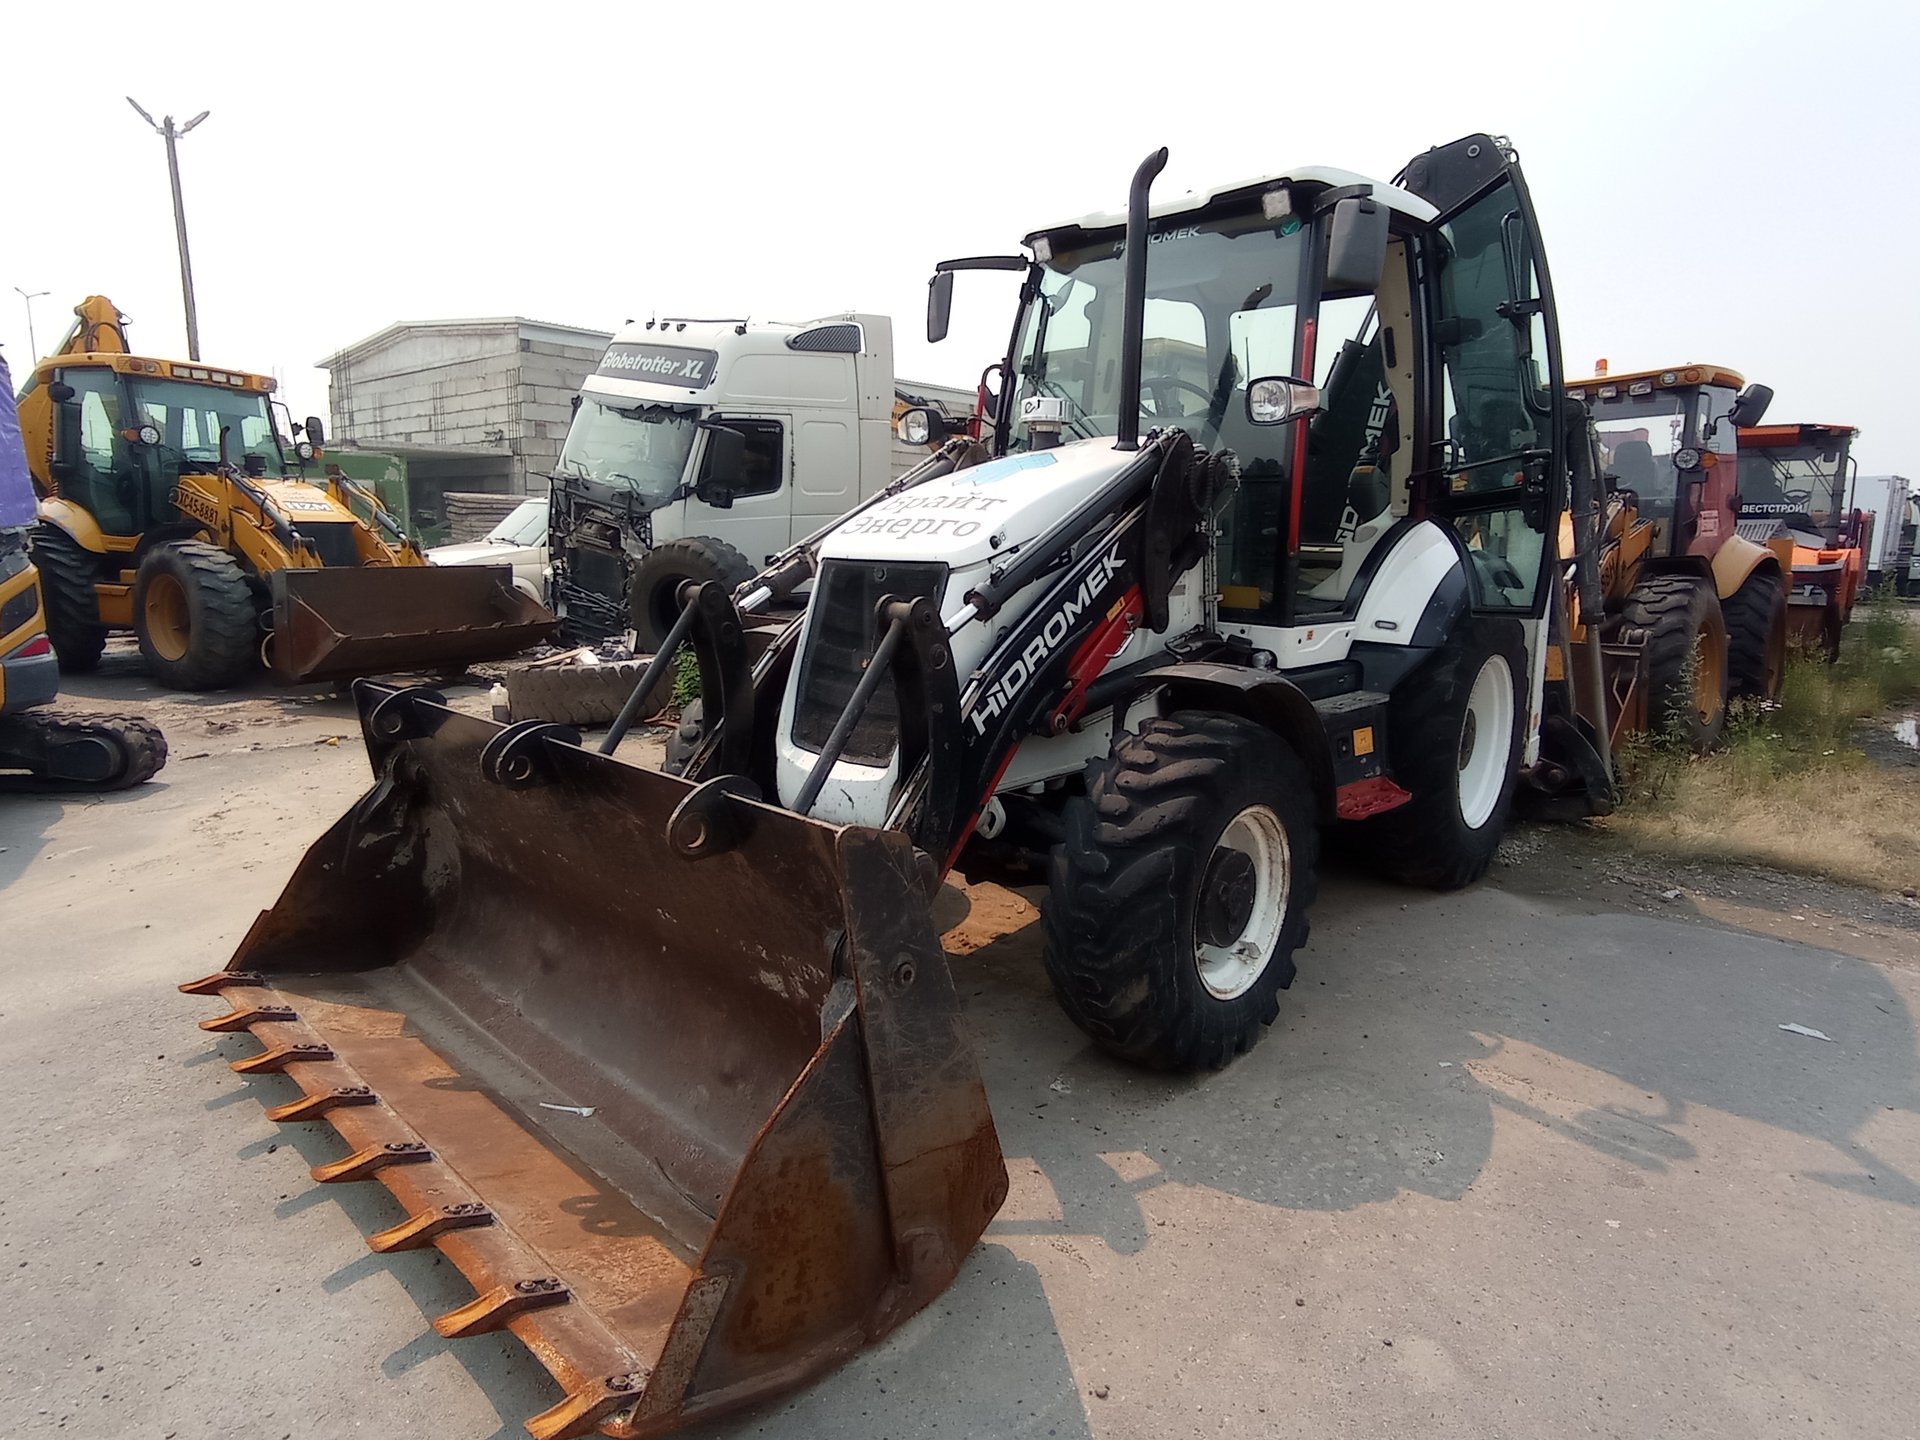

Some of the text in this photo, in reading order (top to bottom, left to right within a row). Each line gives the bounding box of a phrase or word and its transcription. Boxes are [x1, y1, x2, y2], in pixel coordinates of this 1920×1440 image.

[602, 351, 704, 379] Globetrotter XL
[878, 491, 1007, 514] Брайт
[841, 516, 981, 540] Энерго
